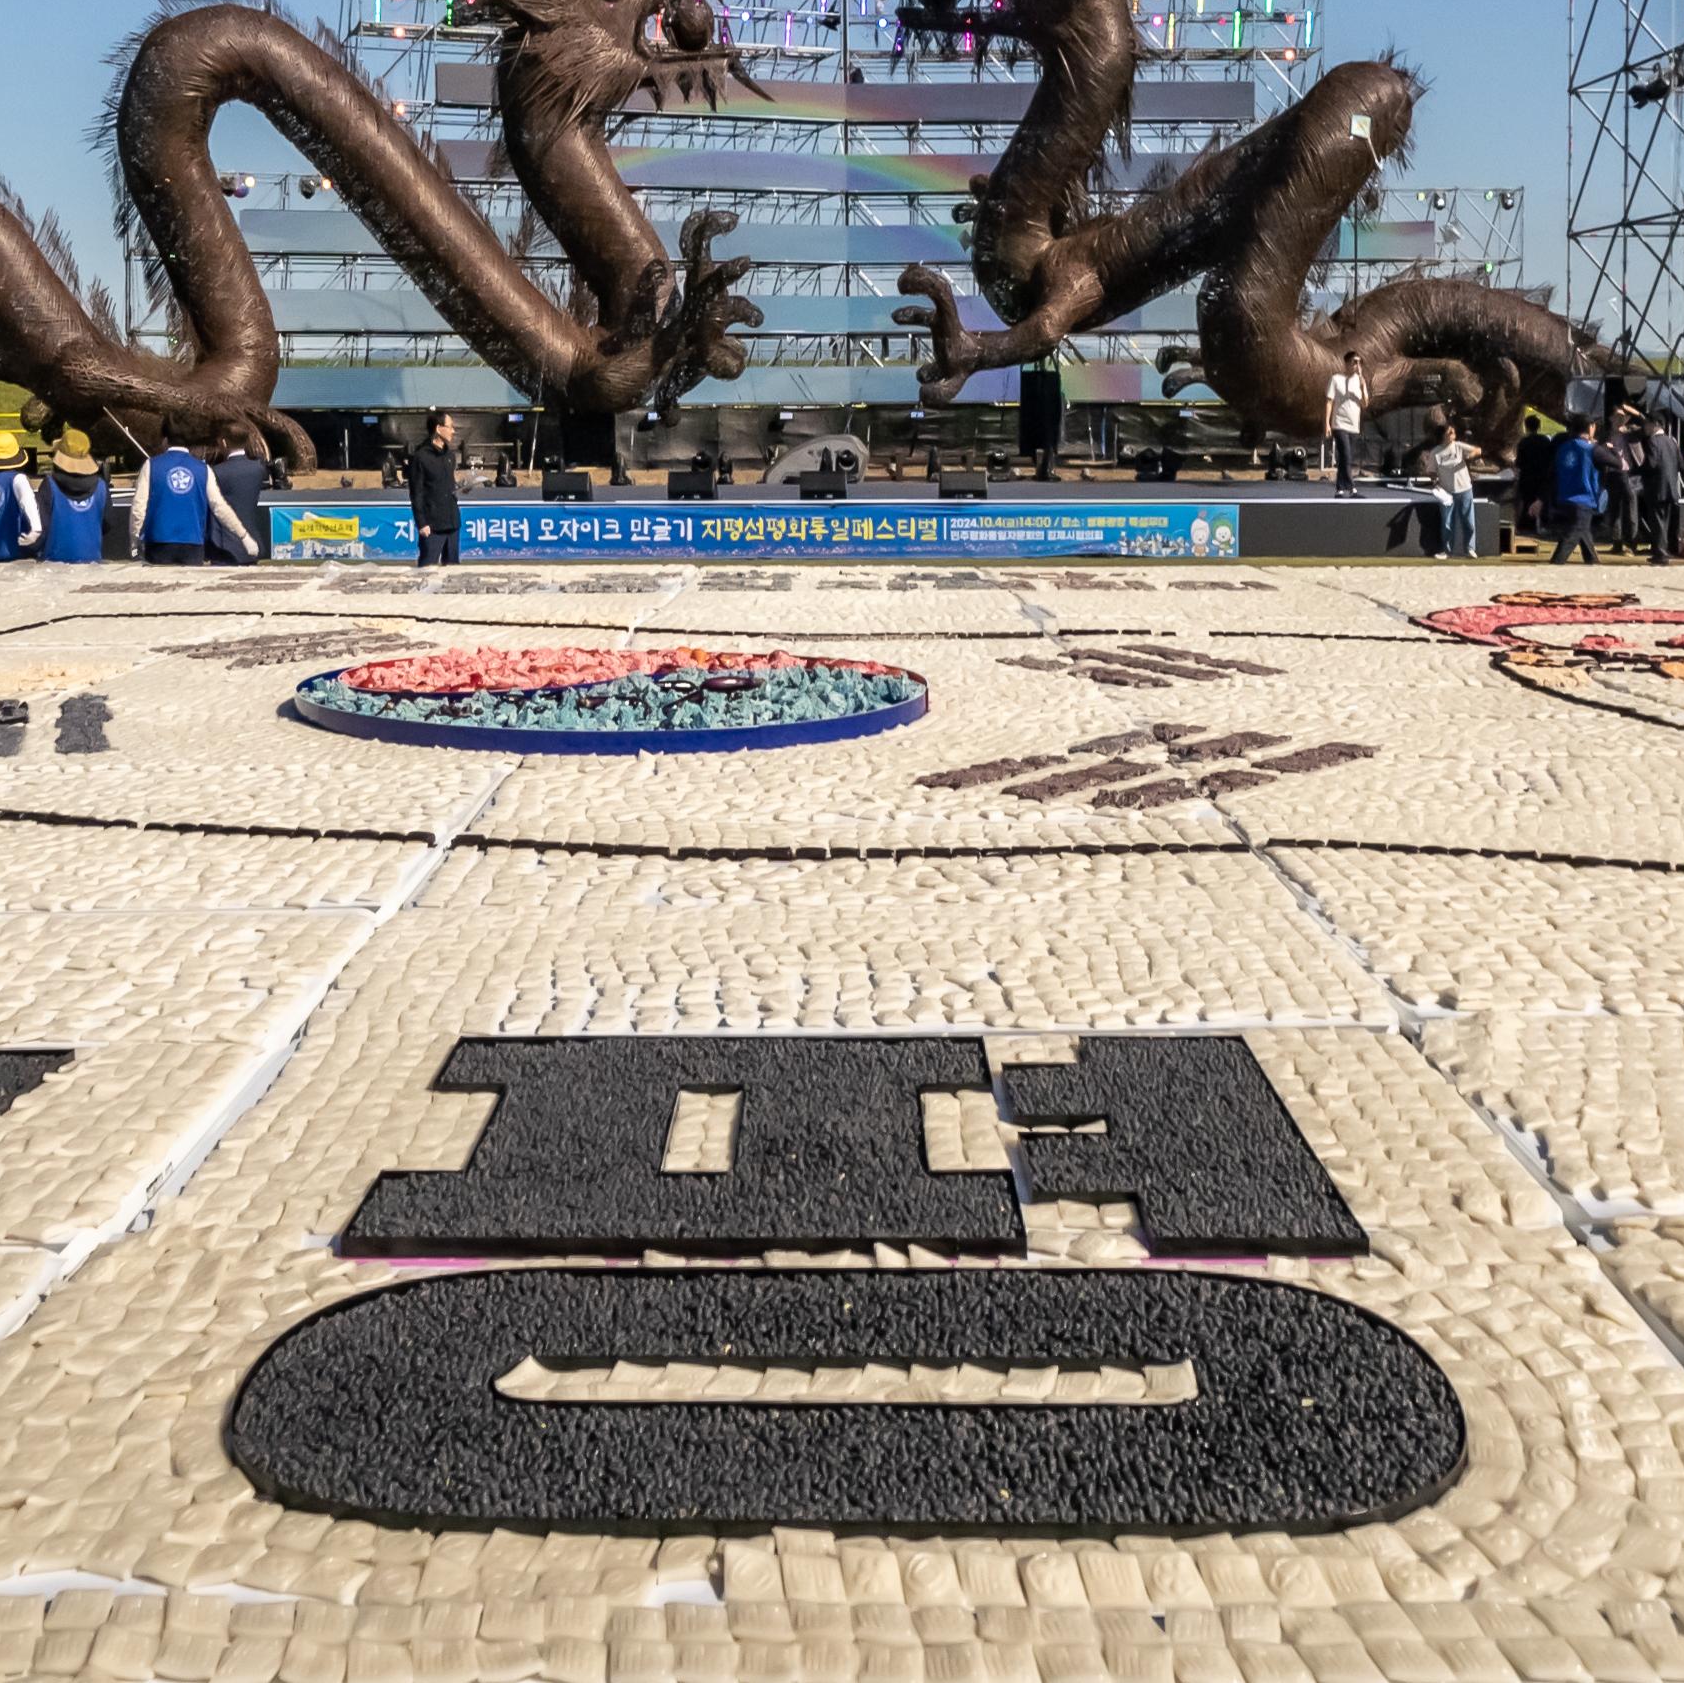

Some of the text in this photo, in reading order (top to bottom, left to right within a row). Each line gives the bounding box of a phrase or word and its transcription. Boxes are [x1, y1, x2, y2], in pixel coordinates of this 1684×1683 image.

[465, 517, 529, 542] 캐릭터
[537, 517, 622, 542] 모자이크
[701, 517, 937, 541] 지평선평화통일페스티벌
